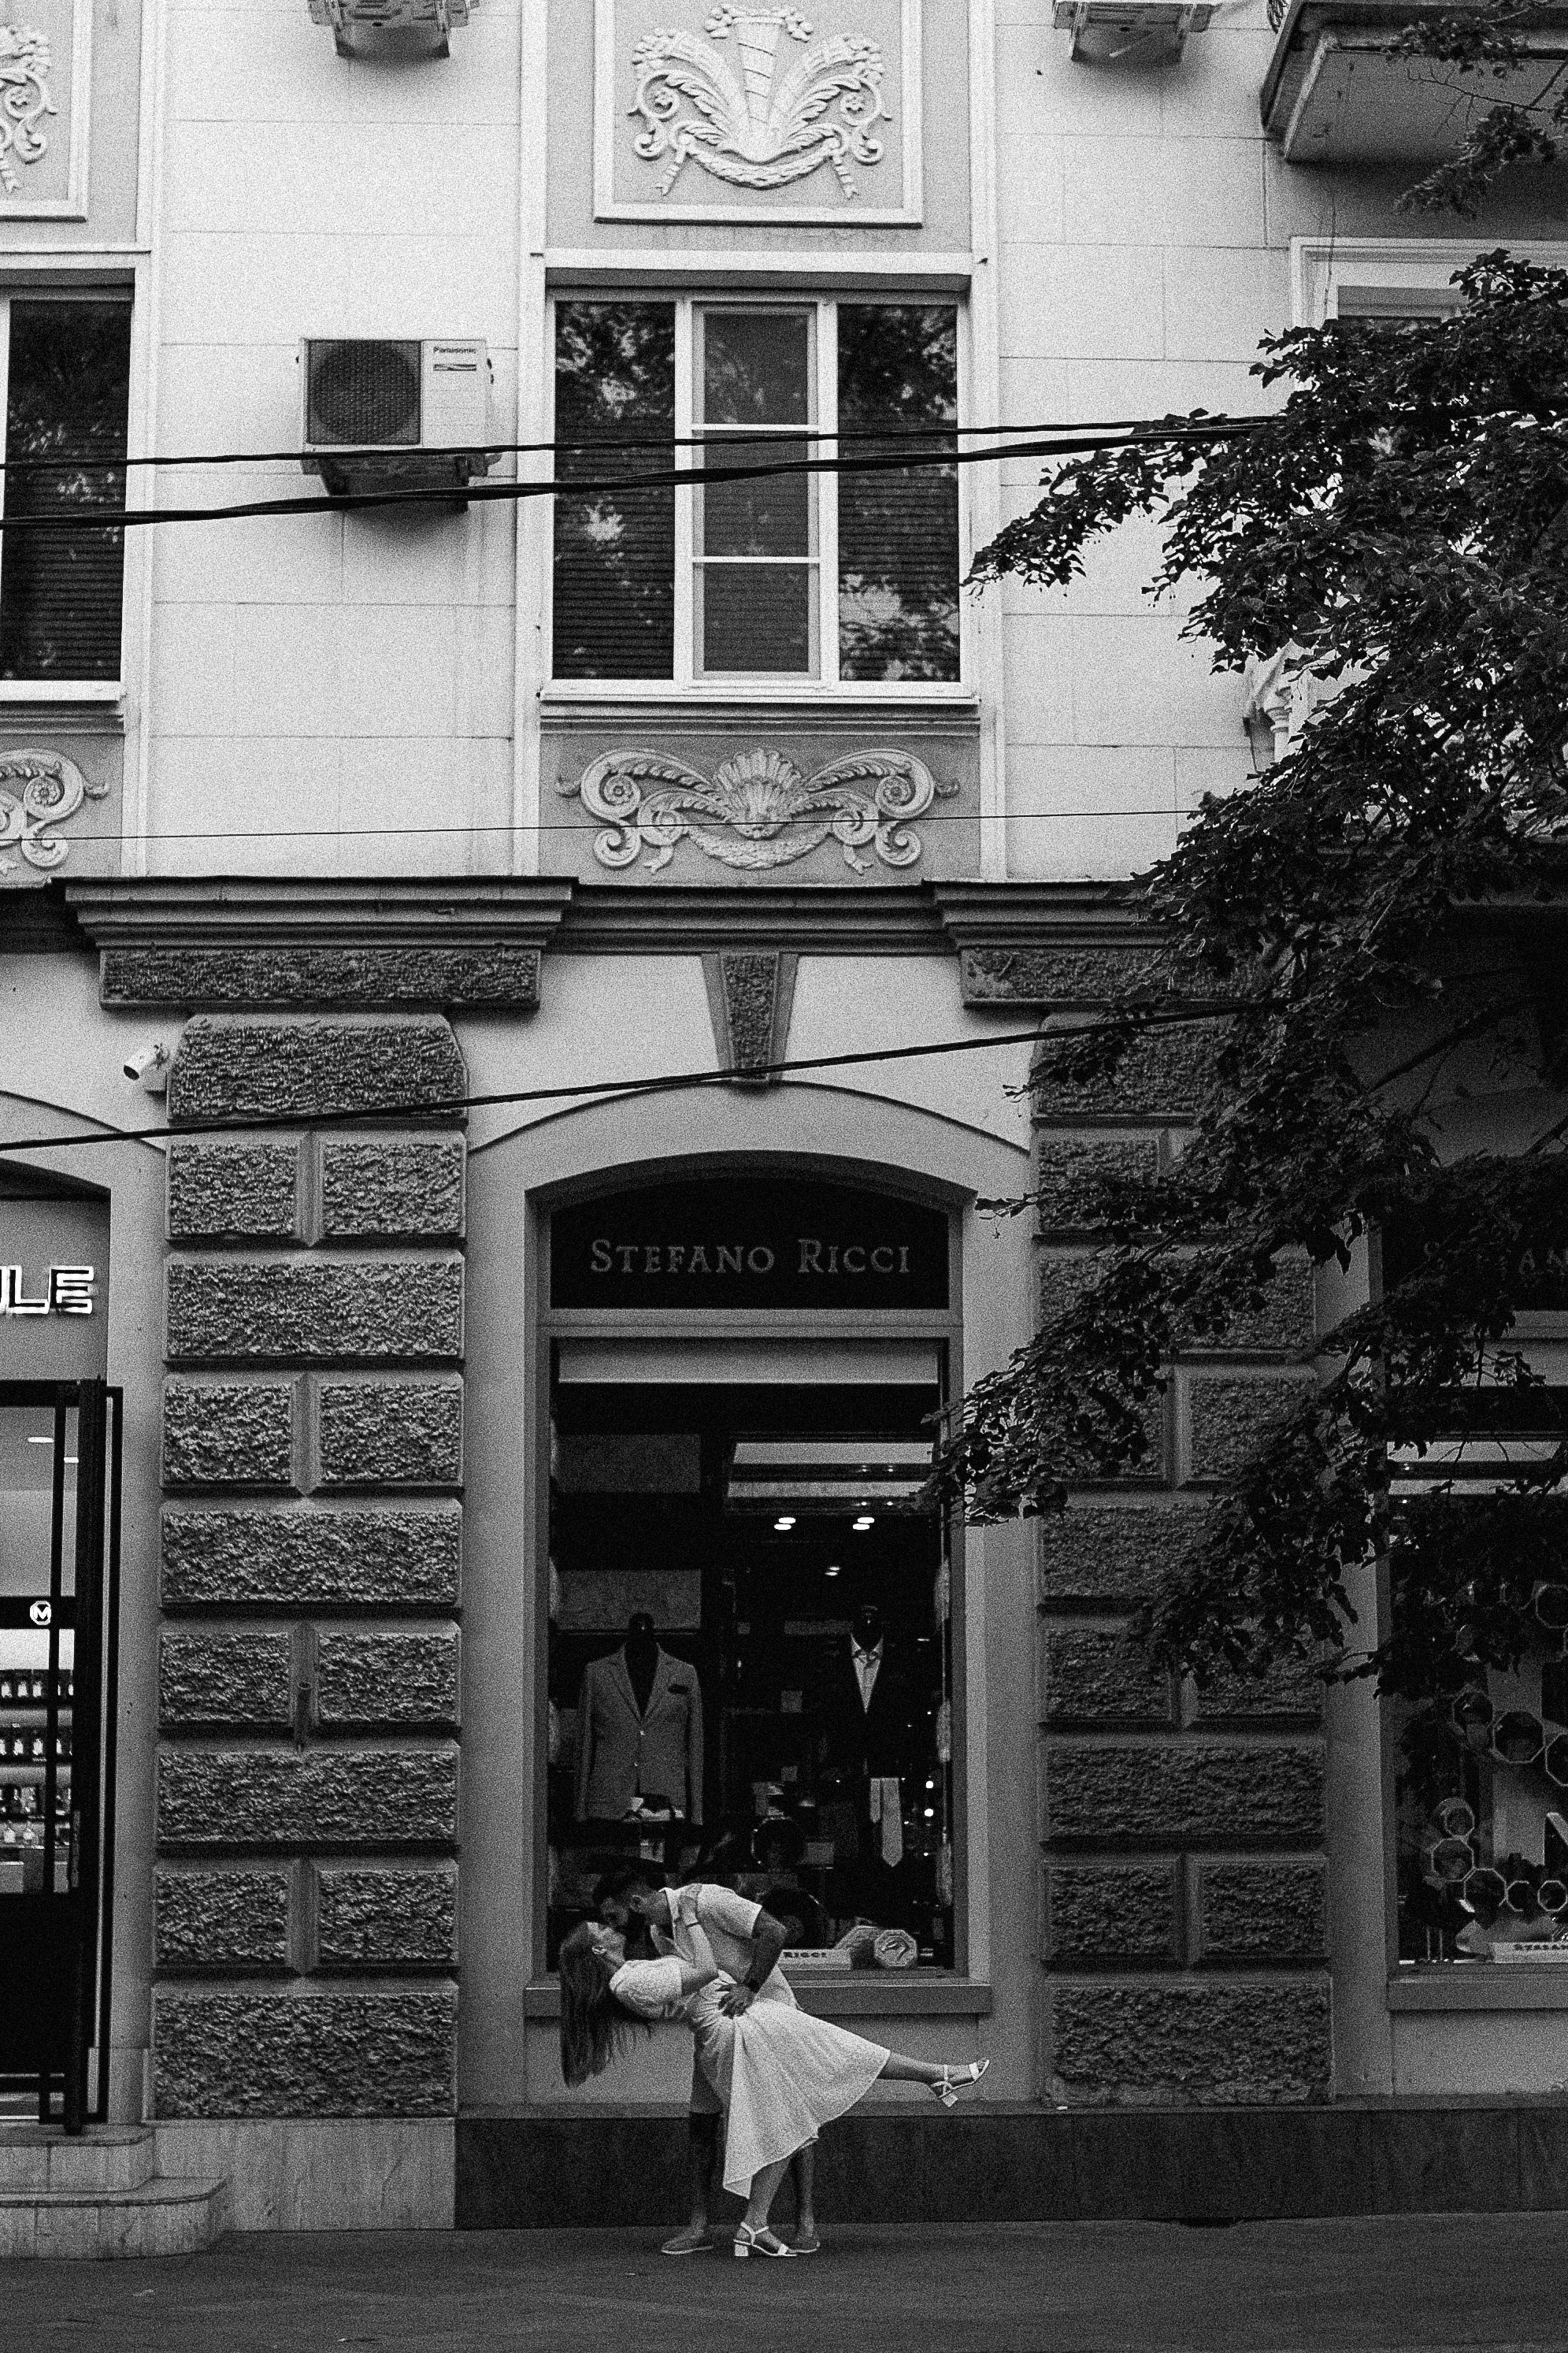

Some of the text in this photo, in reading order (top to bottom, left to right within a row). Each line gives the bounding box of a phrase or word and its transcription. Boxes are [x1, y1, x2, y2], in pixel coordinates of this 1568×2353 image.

[591, 1238, 910, 1273] STEFANO RICCI
[0, 1265, 94, 1315] LE
